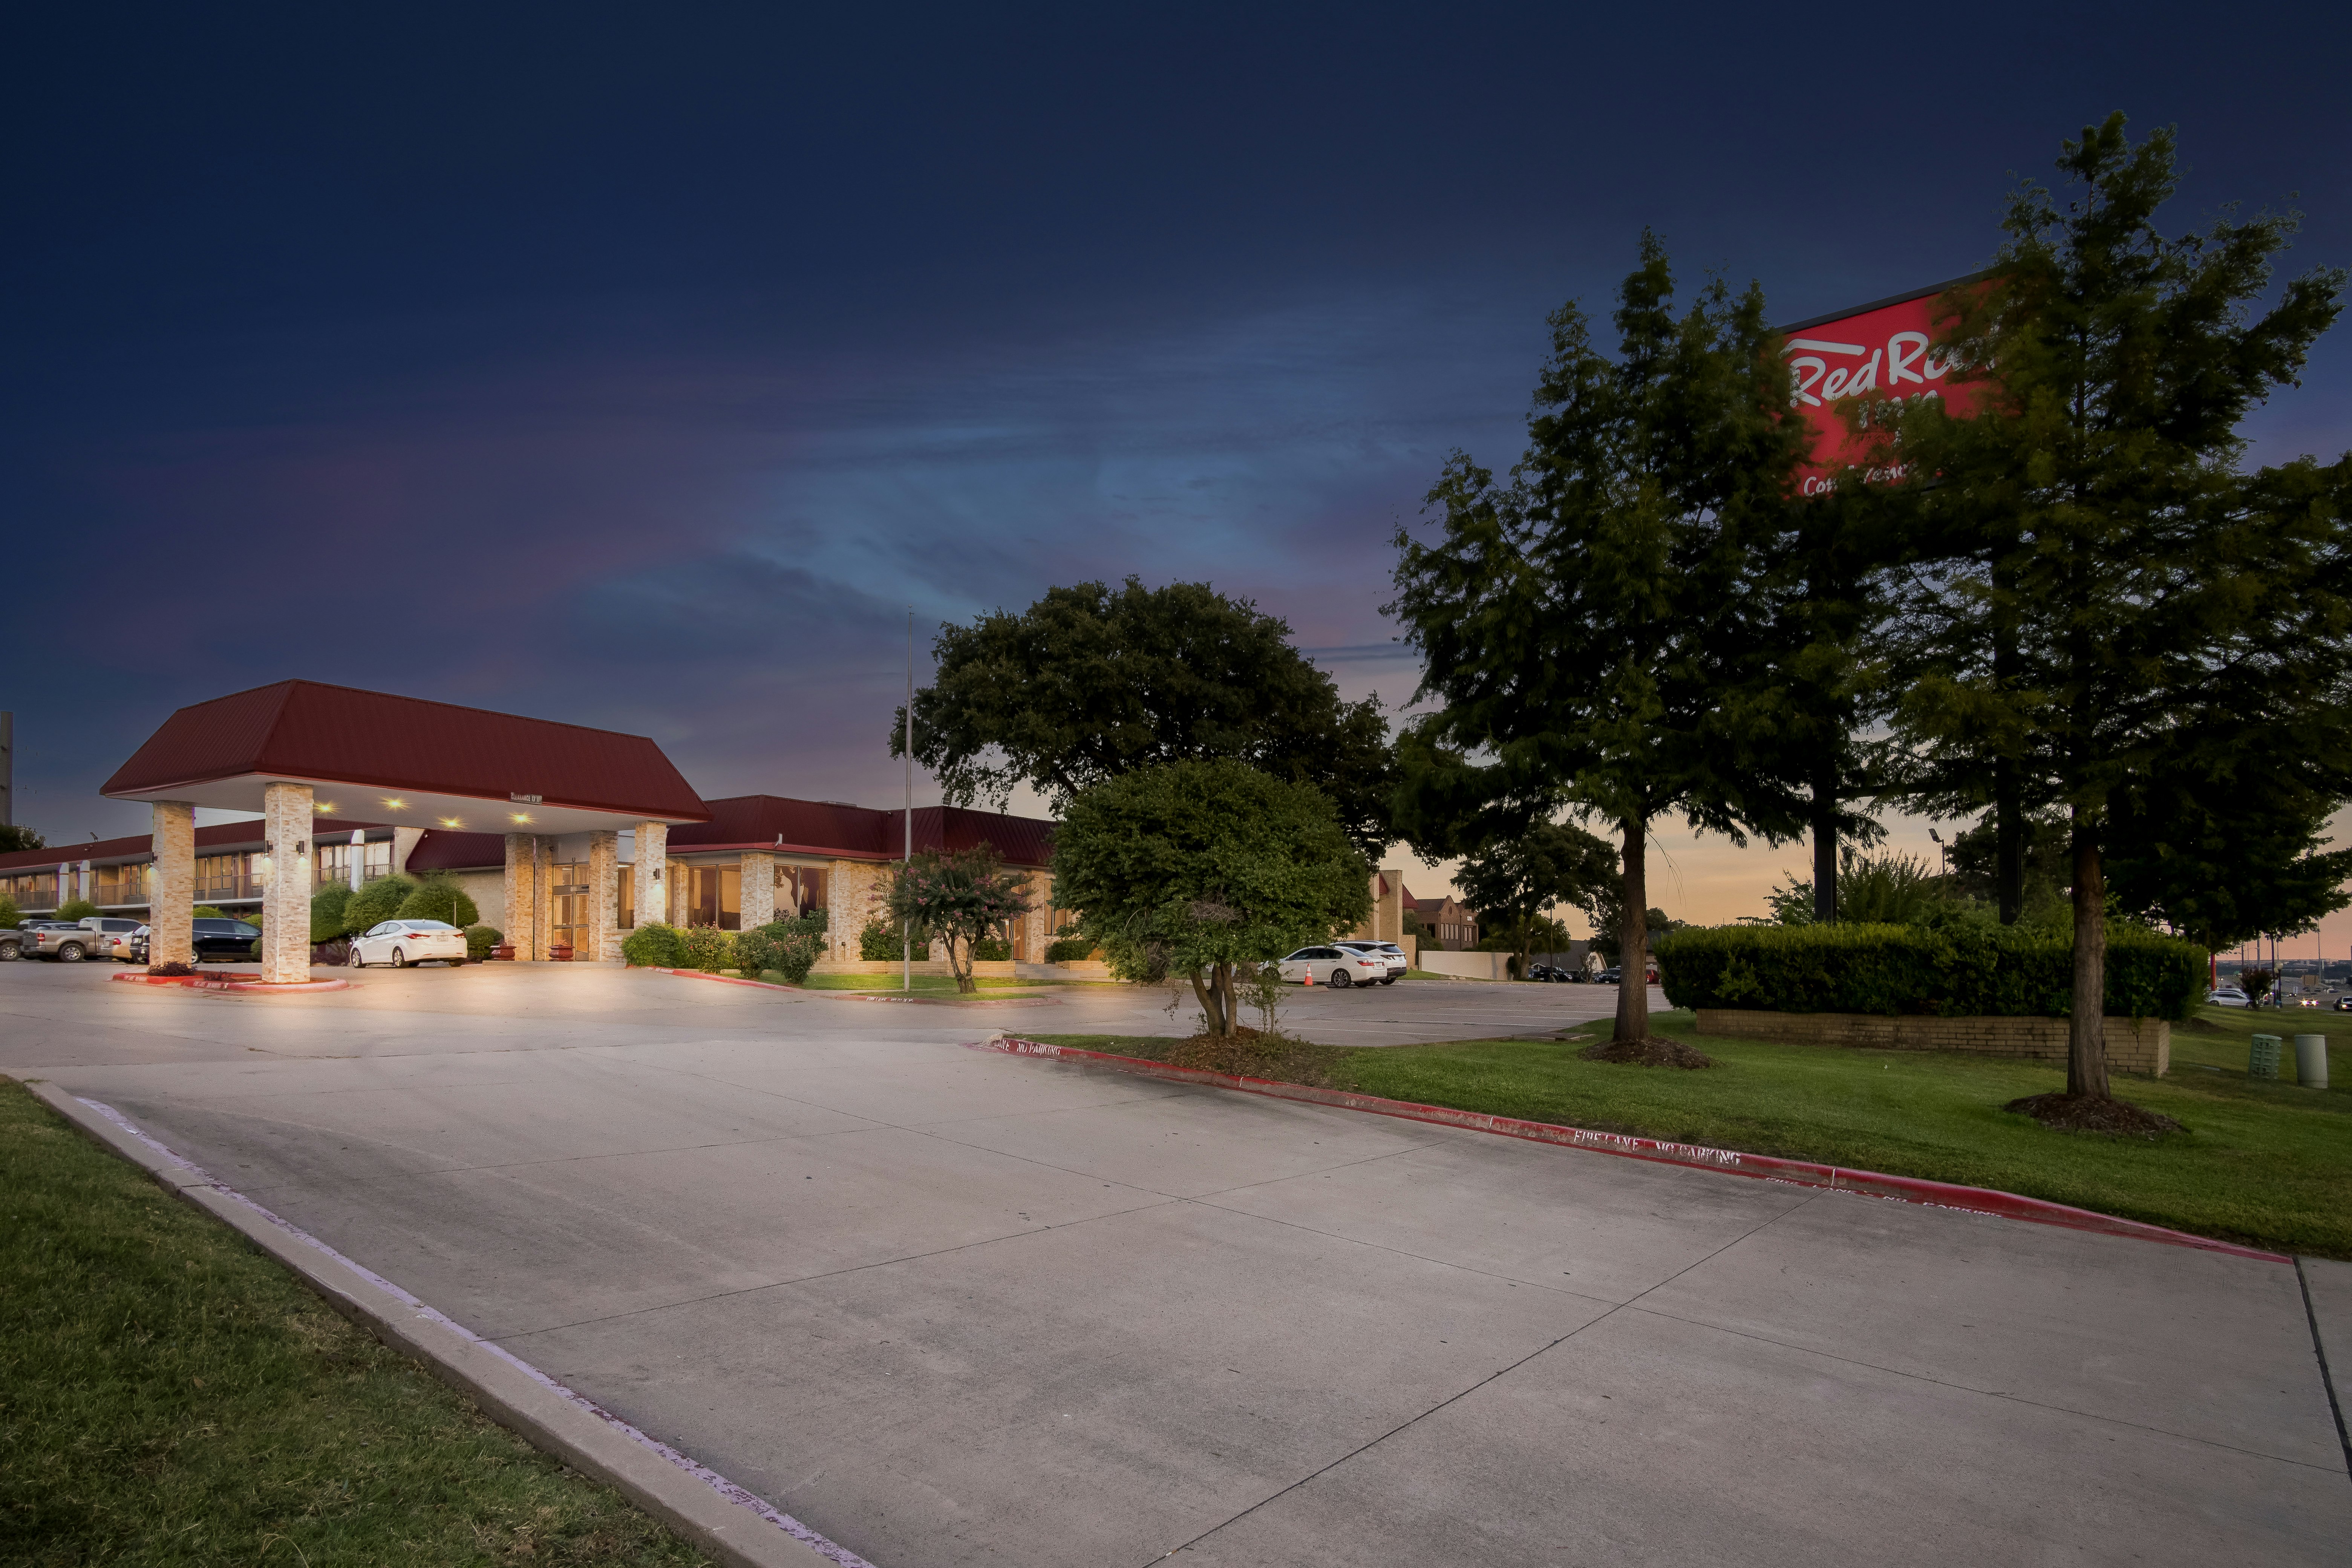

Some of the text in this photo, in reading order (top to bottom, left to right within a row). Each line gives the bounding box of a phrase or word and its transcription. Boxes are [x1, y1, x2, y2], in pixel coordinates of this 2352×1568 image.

[1790, 348, 1882, 408] Red
[1017, 1043, 1028, 1053] NO
[1029, 1043, 1061, 1056] PARKING
